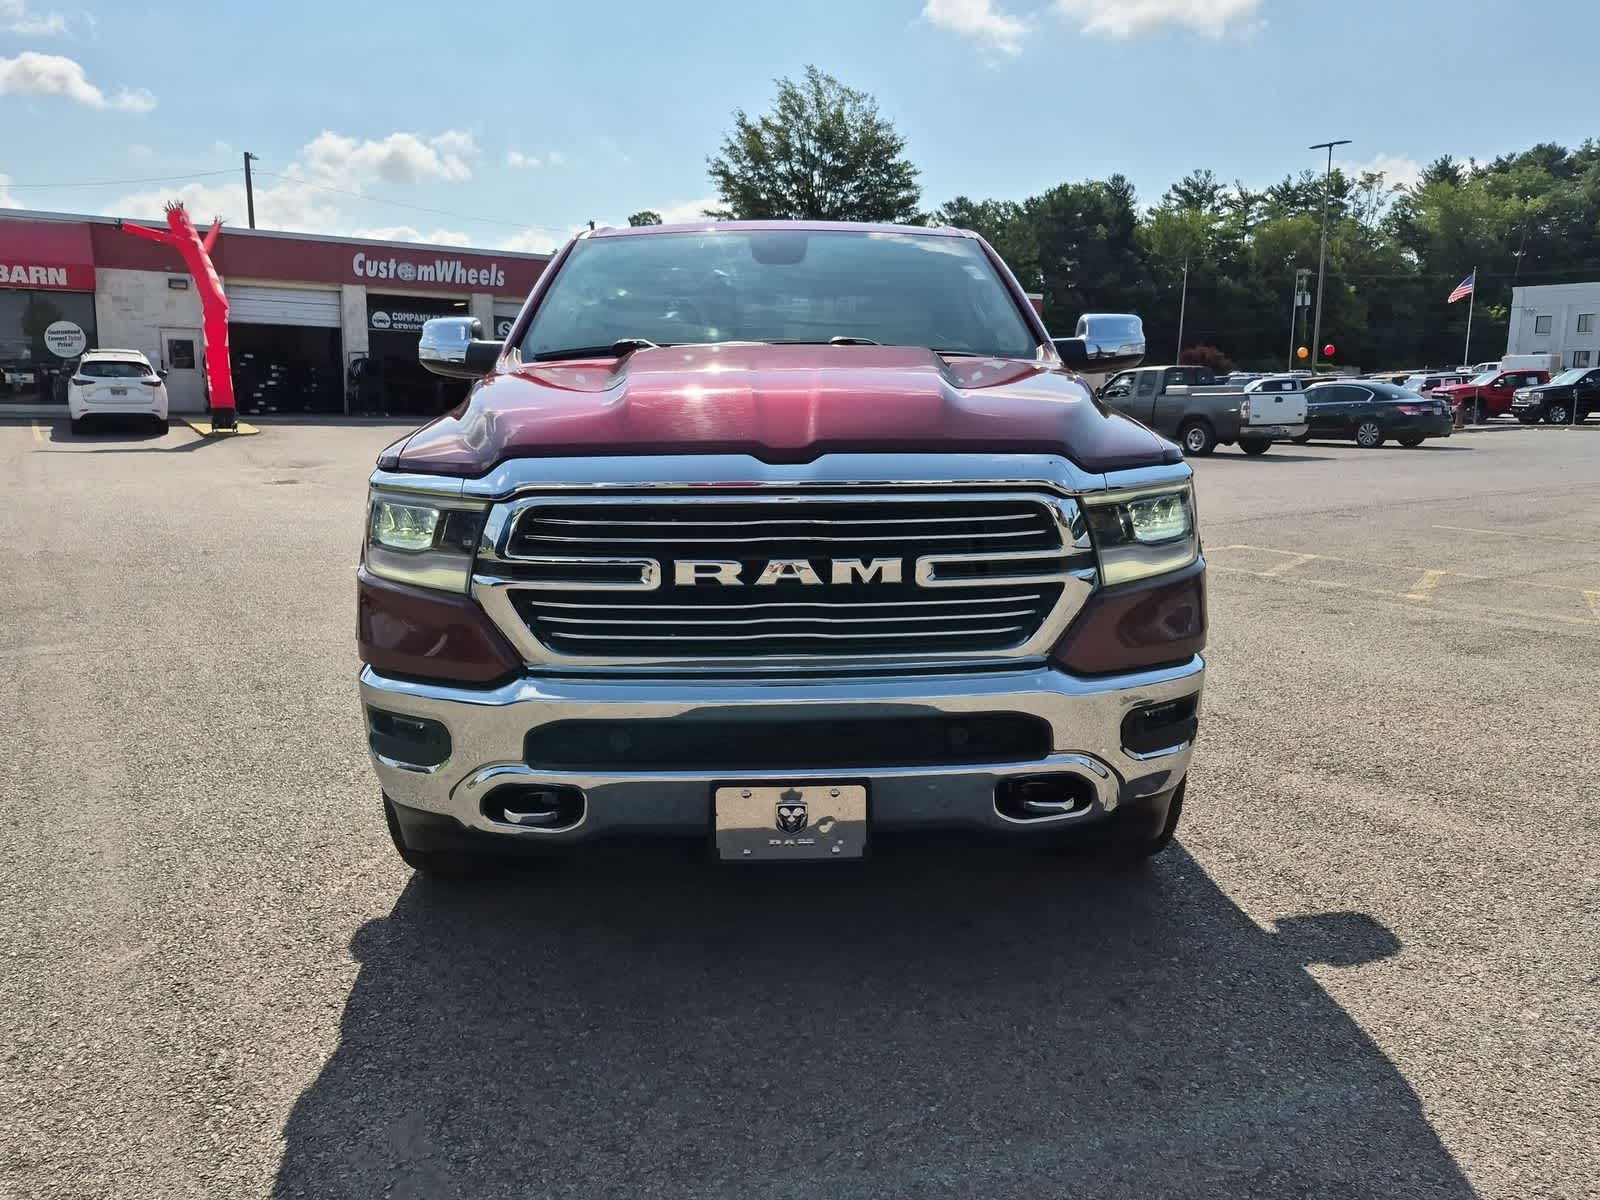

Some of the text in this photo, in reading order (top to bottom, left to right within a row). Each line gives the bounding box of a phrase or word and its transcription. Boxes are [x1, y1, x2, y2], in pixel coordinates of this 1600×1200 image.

[0, 264, 68, 286] BARN
[392, 312, 431, 322] COMPANY
[673, 557, 902, 586] RAM
